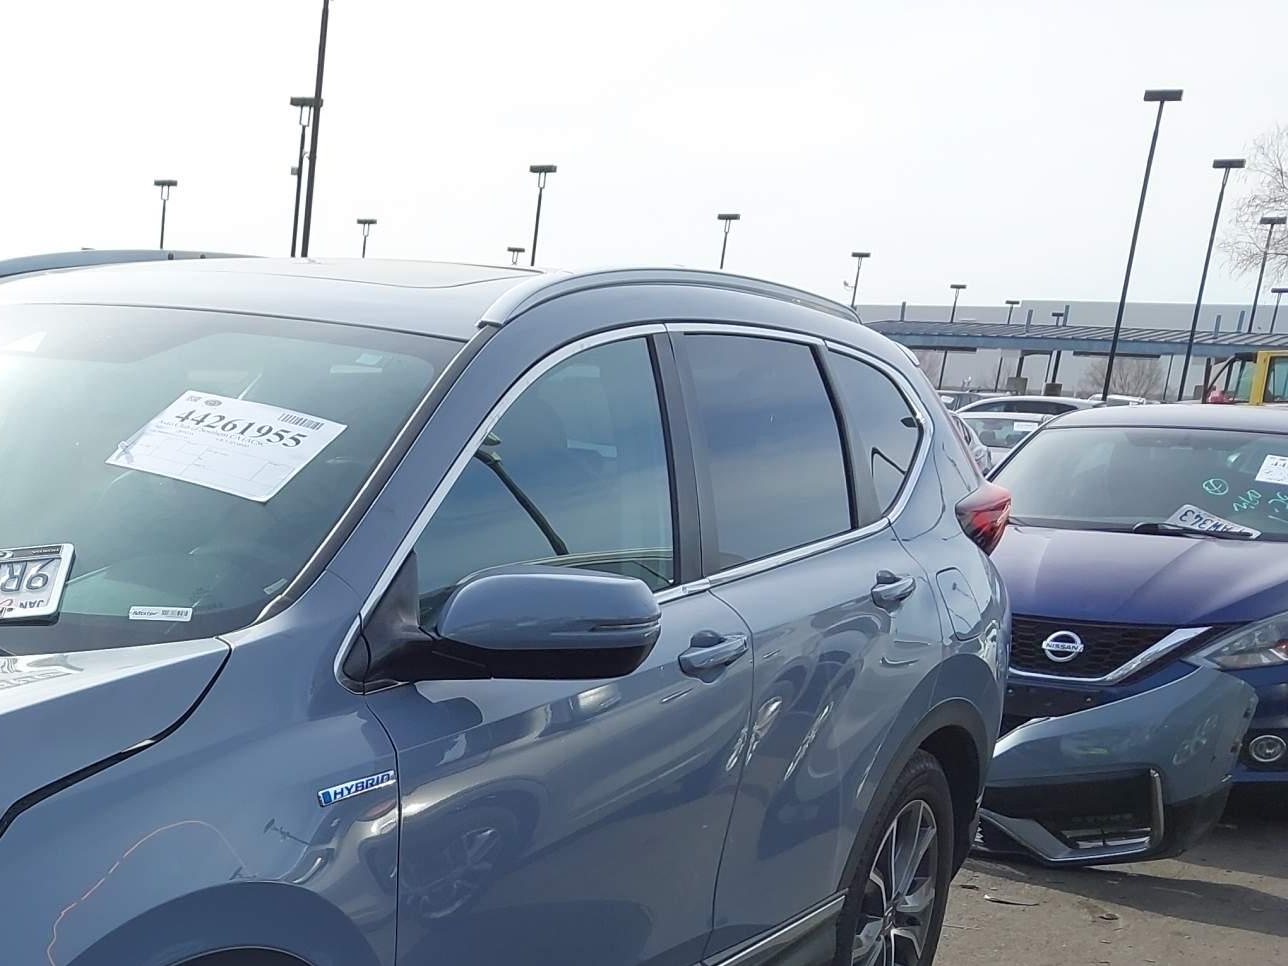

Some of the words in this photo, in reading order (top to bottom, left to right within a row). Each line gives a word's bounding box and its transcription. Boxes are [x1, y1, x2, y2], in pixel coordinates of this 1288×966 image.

[175, 409, 310, 448] 44261955
[1178, 509, 1243, 533] AW343
[1046, 642, 1080, 651] NISSAN
[333, 772, 391, 801] HYBRID
